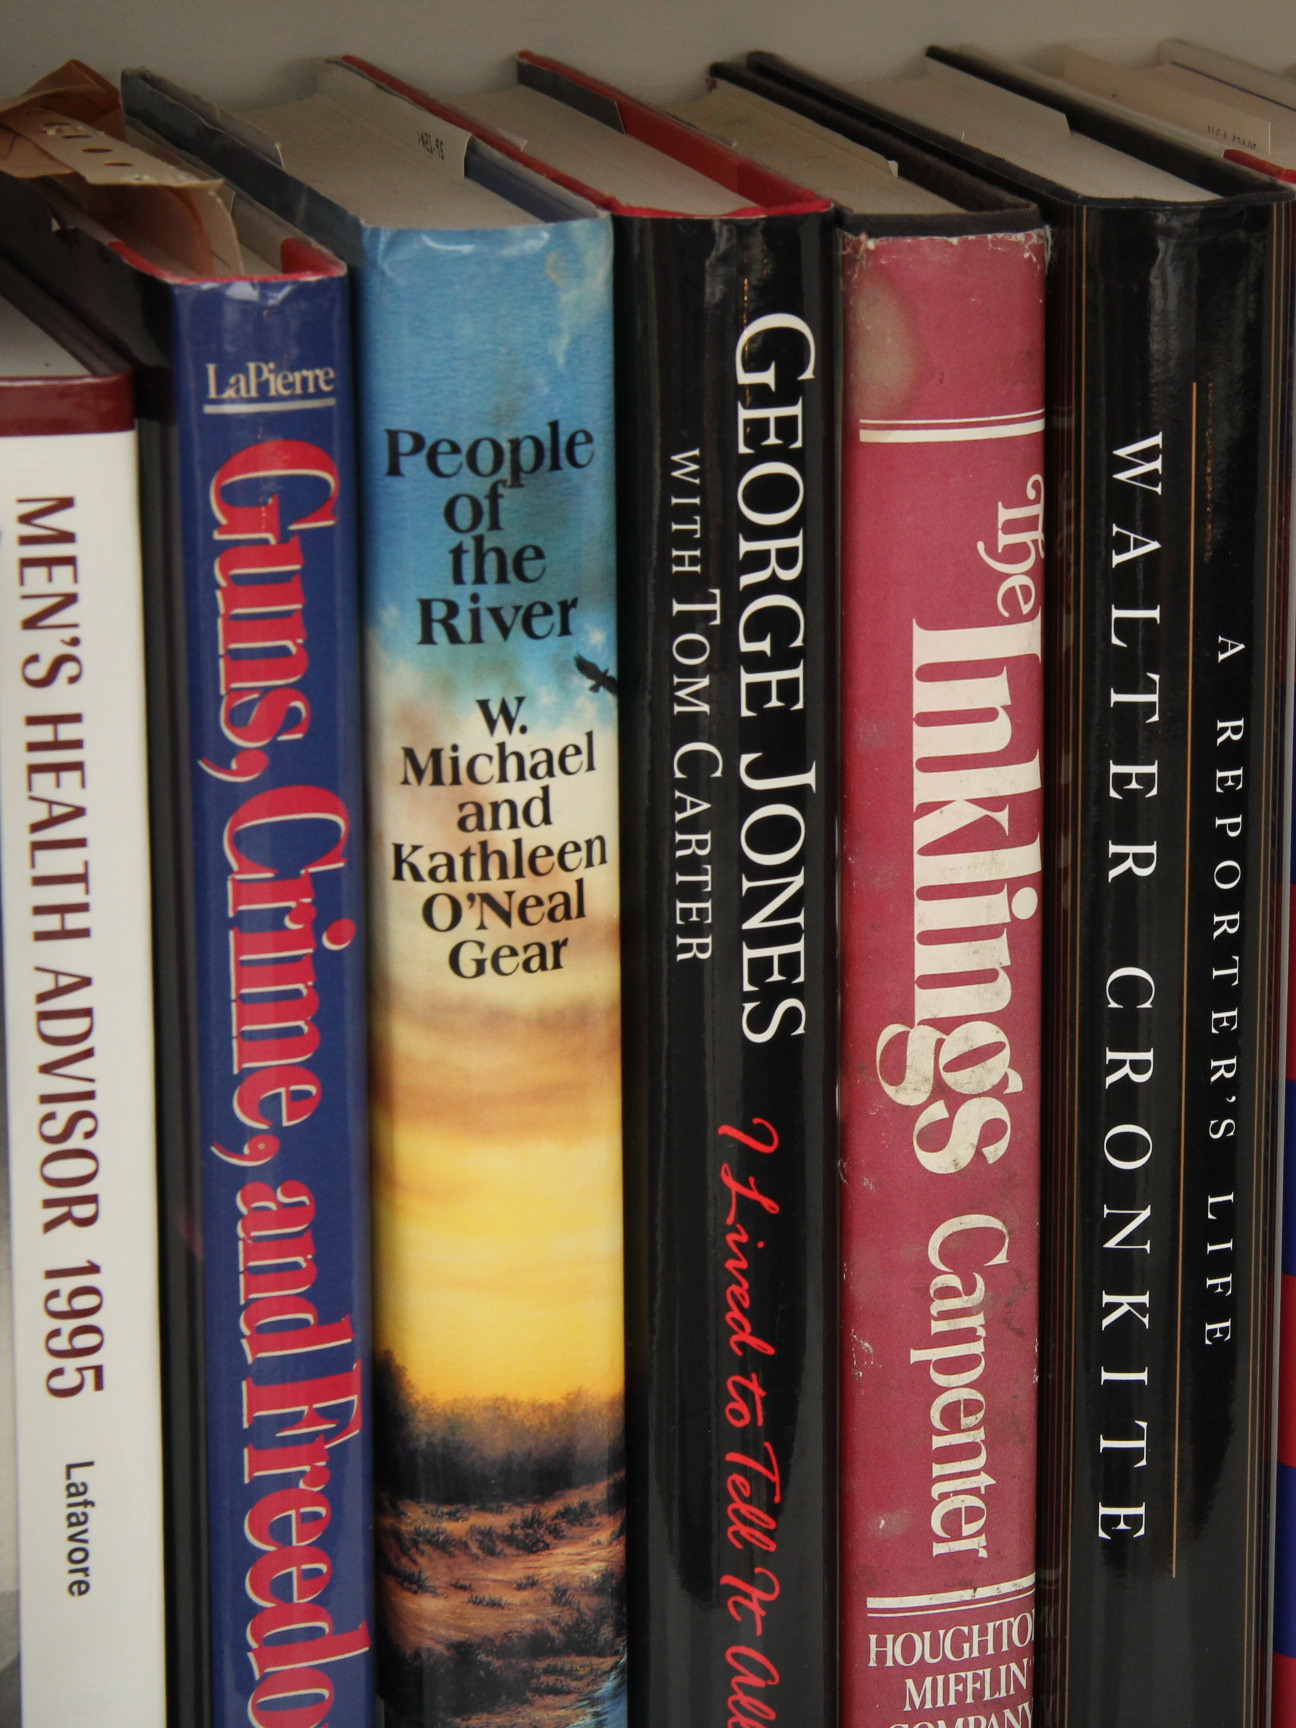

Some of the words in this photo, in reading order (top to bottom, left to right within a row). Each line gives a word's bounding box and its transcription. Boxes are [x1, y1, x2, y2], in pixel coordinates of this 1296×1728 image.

[205, 361, 336, 399] LaPierre
[384, 420, 594, 489] People
[444, 477, 509, 533] of
[669, 447, 702, 574] WITH
[735, 313, 815, 717] GEORGE
[15, 496, 83, 689] MEN'S
[198, 438, 341, 783] Guns,
[449, 535, 547, 585] the
[976, 473, 1045, 618] The
[416, 592, 579, 645] River
[672, 588, 722, 717] TOM
[1107, 431, 1163, 884] WALTER
[1217, 635, 1246, 663] A
[400, 731, 595, 787] Michael
[476, 696, 527, 737] W.
[24, 711, 92, 943] HEALTH
[392, 833, 608, 883] Kathleen
[457, 785, 553, 833] and
[673, 741, 724, 962] CARTER
[422, 879, 587, 933] O'Neal
[448, 936, 568, 980] Gear
[738, 752, 817, 1044] JONES
[876, 605, 1043, 1176] Inklings
[1207, 716, 1245, 1140] REPORTER'S
[211, 784, 357, 1167] Crime,
[33, 964, 101, 1235] ADVISOR
[236, 1178, 356, 1365] and
[719, 1161, 780, 1362] Lived
[1098, 966, 1156, 1541] CRONKITE
[1204, 1192, 1235, 1346] LIFE
[43, 1257, 105, 1400] 1995
[909, 1213, 1011, 1559] Carpenter
[725, 1370, 767, 1429] to
[65, 1459, 96, 1599] Lafavore
[242, 1358, 372, 1728] Freedo
[723, 1441, 781, 1551] Tell
[720, 1566, 781, 1636] It
[868, 1611, 1034, 1667] HOUGHTO
[903, 1657, 1029, 1711] MIFFLIN
